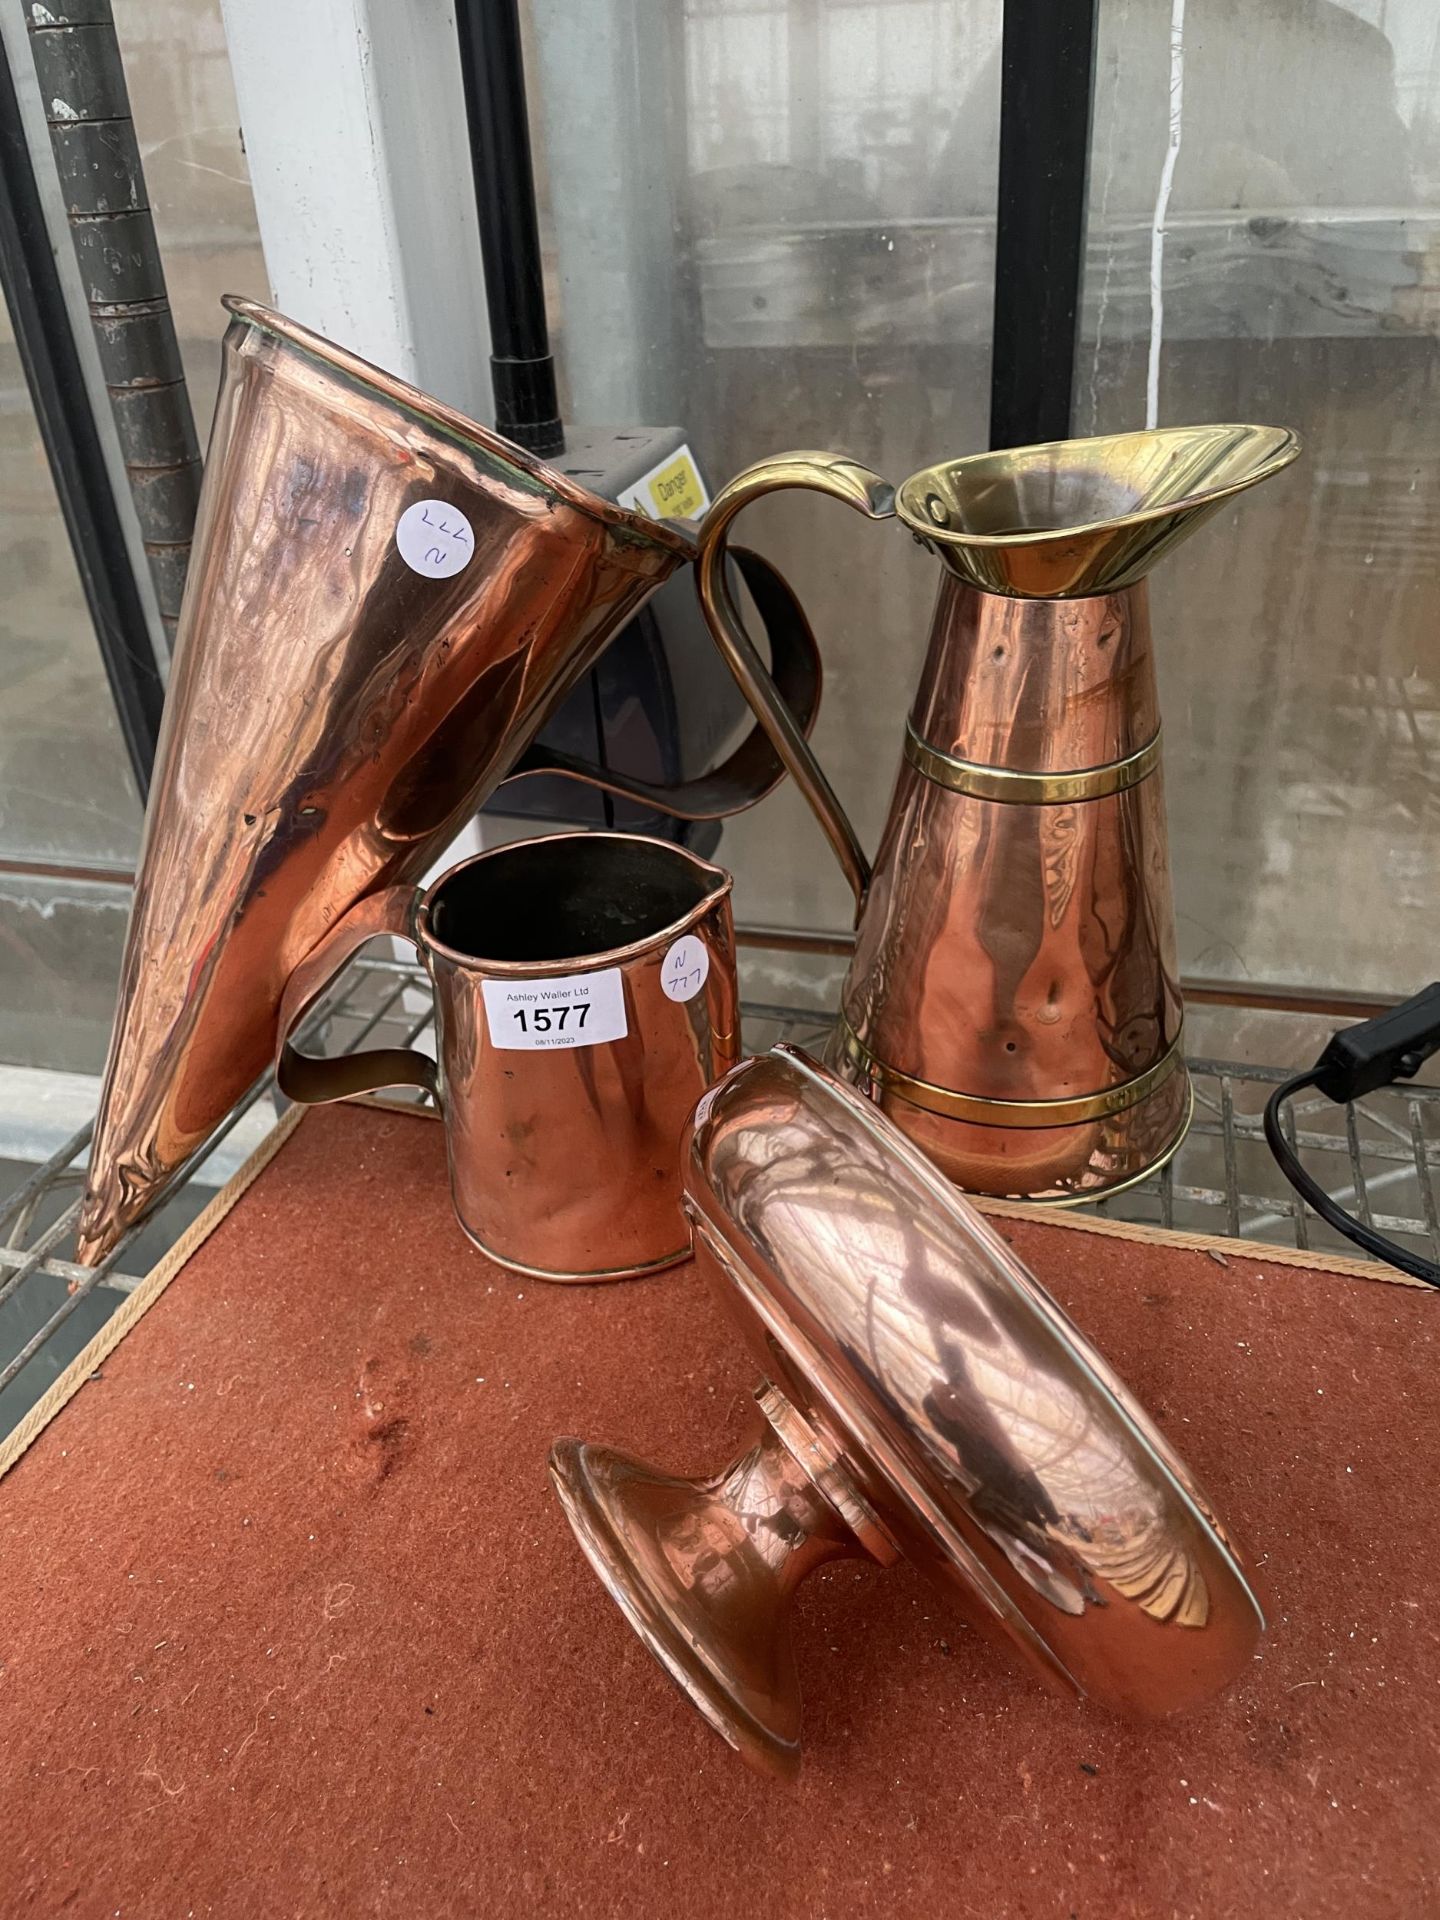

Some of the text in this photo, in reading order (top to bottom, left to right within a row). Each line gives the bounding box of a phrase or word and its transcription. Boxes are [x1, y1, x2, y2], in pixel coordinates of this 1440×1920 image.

[656, 469, 687, 502] Danger
[674, 949, 687, 969] N
[667, 968, 701, 993] 777
[506, 987, 589, 1003] Ashley Waller Ltd
[513, 1003, 591, 1032] 1577
[535, 1037, 575, 1046] 08/11/2023
